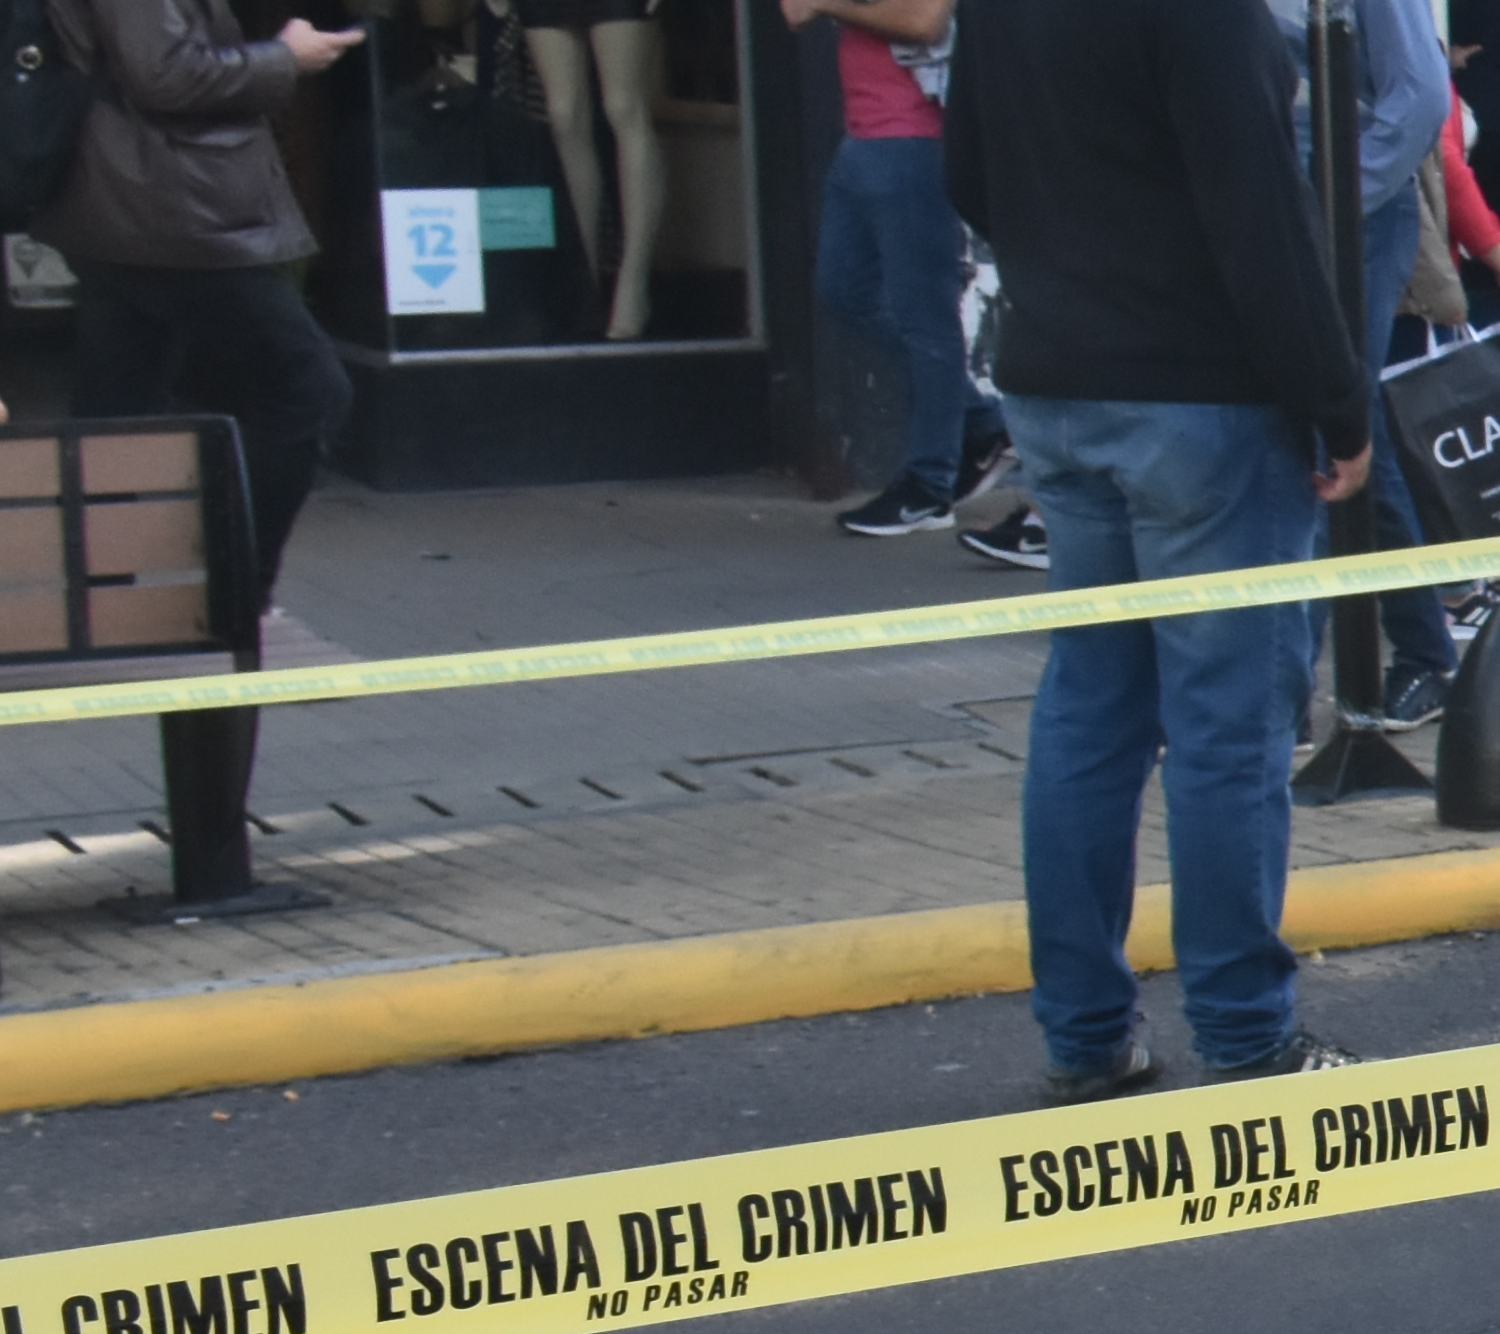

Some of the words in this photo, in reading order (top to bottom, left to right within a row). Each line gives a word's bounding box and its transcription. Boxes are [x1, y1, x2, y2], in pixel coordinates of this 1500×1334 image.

[408, 223, 458, 258] 12
[1000, 1130, 1195, 1222] ESCENA
[1214, 1117, 1295, 1189] DEL
[1312, 1085, 1490, 1174] CRIMEN
[1180, 1196, 1220, 1227] NO
[1227, 1179, 1322, 1219] PASAR
[369, 1220, 600, 1322] ESCENA
[621, 1202, 719, 1283] DEL
[737, 1167, 949, 1263] CRIMEN
[586, 1291, 628, 1322] NO
[643, 1270, 750, 1311] PASAR
